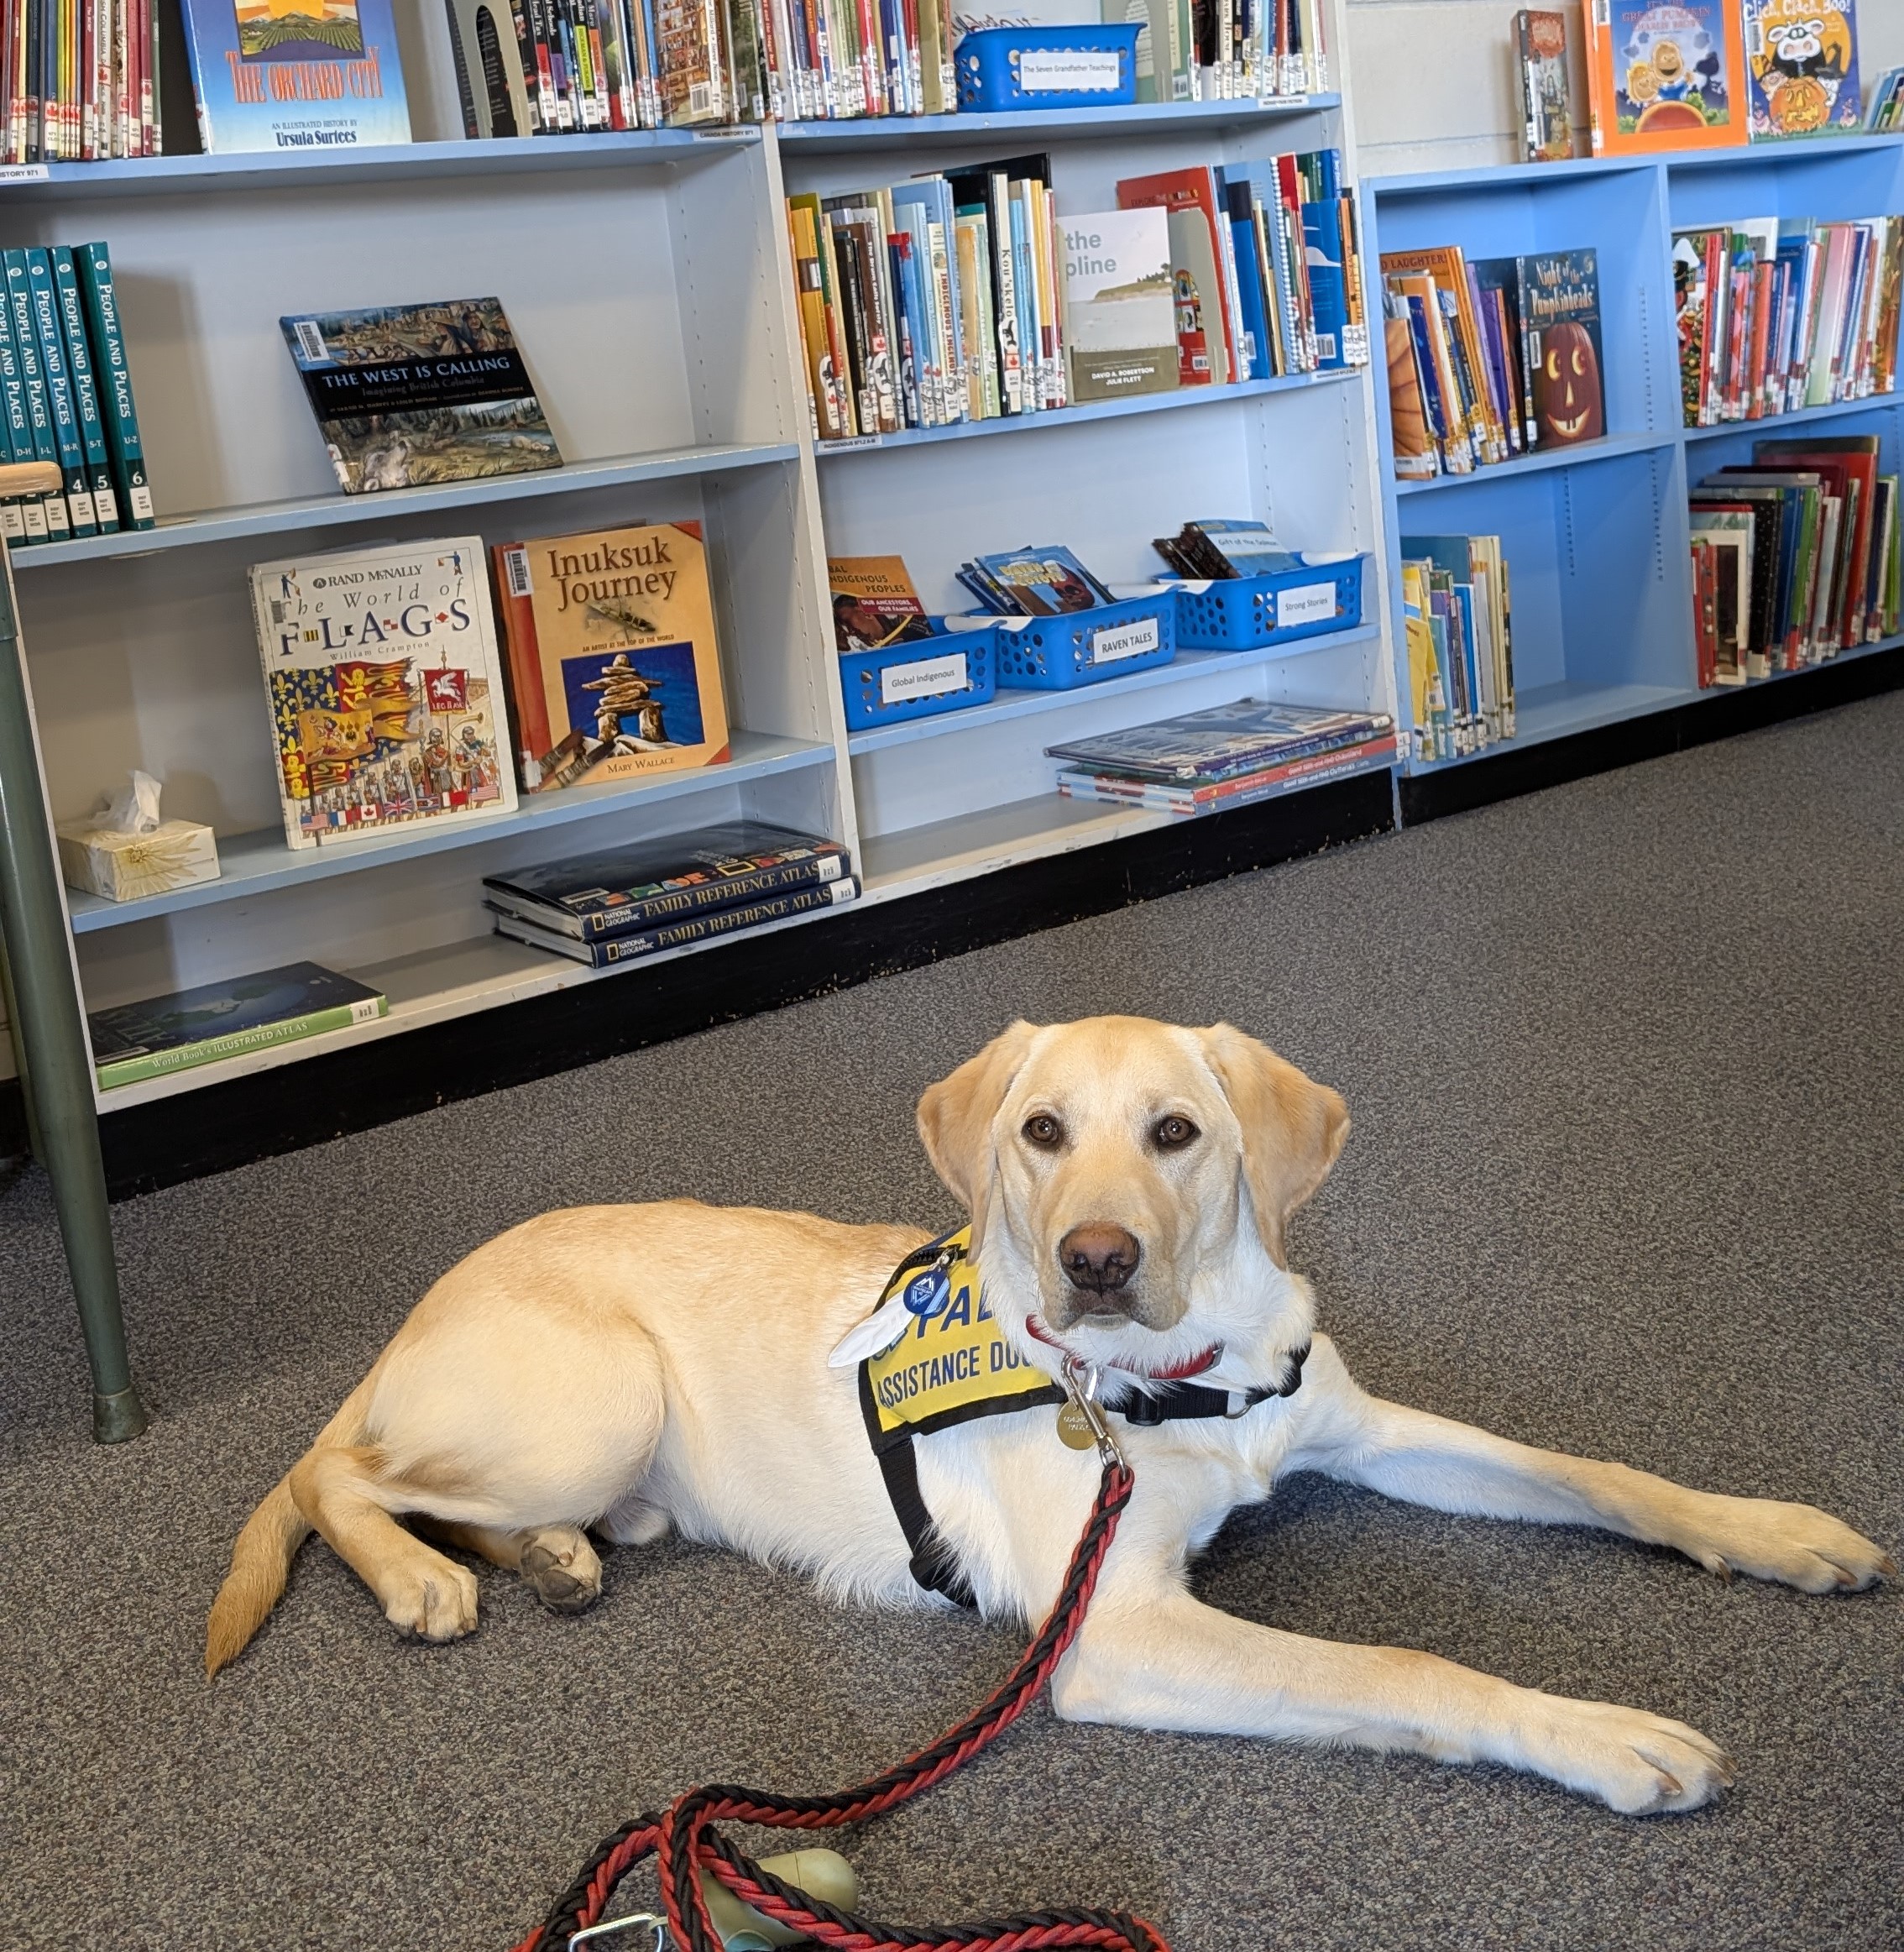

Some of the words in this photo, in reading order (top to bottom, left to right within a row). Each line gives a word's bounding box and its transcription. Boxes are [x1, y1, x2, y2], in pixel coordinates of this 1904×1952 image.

[99, 13, 107, 55] COLUMBIA
[225, 47, 266, 103] THE
[268, 60, 344, 102] ORCHARD
[346, 47, 384, 99] CITY
[1054, 65, 1088, 73] Grandfather
[1089, 65, 1117, 73] Teachings
[276, 130, 314, 147] Ursula
[1064, 230, 1101, 250] the
[1065, 256, 1117, 281] pline
[1390, 254, 1447, 270] LAUGHTER!
[36, 290, 55, 340] PEOPLE
[63, 288, 81, 338] PEOPLE
[99, 284, 117, 334] PEOPLE
[939, 272, 953, 332] INDIGENOUS
[0, 294, 10, 343] PEOPLE
[14, 292, 32, 343] PEOPLE
[0, 348, 15, 376] AND
[22, 348, 37, 375] AND
[46, 346, 61, 373] AND
[72, 342, 86, 369] AND
[108, 339, 123, 366] AND
[322, 373, 358, 389] THE
[363, 368, 409, 384] WEST
[415, 364, 432, 379] IS
[437, 356, 510, 376] CALLING
[78, 374, 96, 422] PLACES
[113, 371, 131, 419] PLACES
[362, 385, 407, 398] Imagining
[409, 379, 440, 393] British
[442, 377, 485, 389] Columbia
[7, 381, 25, 430] PLACES
[29, 380, 47, 428] PLACES
[53, 378, 71, 426] PLACES
[16, 448, 32, 457] D-H
[40, 447, 52, 455] I-L
[63, 444, 79, 453] M-R
[89, 440, 102, 449] S-T
[124, 437, 138, 445] U-Z
[72, 479, 82, 492] 4
[97, 475, 108, 489] 5
[133, 471, 143, 485] 6
[547, 536, 672, 578] Inuksuk
[829, 565, 848, 573] BAL
[327, 573, 364, 588] RAND
[557, 568, 677, 612] Journey
[829, 575, 888, 584] NDIGENOUS
[866, 584, 906, 593] PEOPLES
[343, 583, 420, 609] World
[440, 577, 464, 597] of
[1284, 599, 1306, 611] Strong
[1307, 597, 1328, 607] Stories
[330, 648, 372, 661] William
[378, 641, 430, 654] Crampton
[591, 643, 608, 652] ARTIST
[656, 634, 675, 642] WORLD
[1101, 639, 1129, 654] RAVEN
[1129, 632, 1153, 647] TALES
[891, 675, 916, 688] Global
[916, 669, 955, 685] Indigenous
[607, 761, 633, 774] MARY
[634, 756, 675, 769] WALLACE
[644, 896, 693, 918] FAMILY
[696, 871, 777, 906] REFERENCE
[779, 861, 819, 885] ATLAS
[604, 908, 632, 922] NATIONAL
[657, 927, 702, 947] FAMILY
[709, 899, 789, 930] REFERENCE
[791, 888, 831, 912] ATLAS
[619, 936, 646, 950] NATIONAL
[151, 1053, 181, 1069] World
[182, 1047, 212, 1063] Book's
[213, 1031, 275, 1053] ILLUSTRATED
[275, 1021, 309, 1038] ATLAS
[876, 1341, 981, 1410] ASSISTANCE
